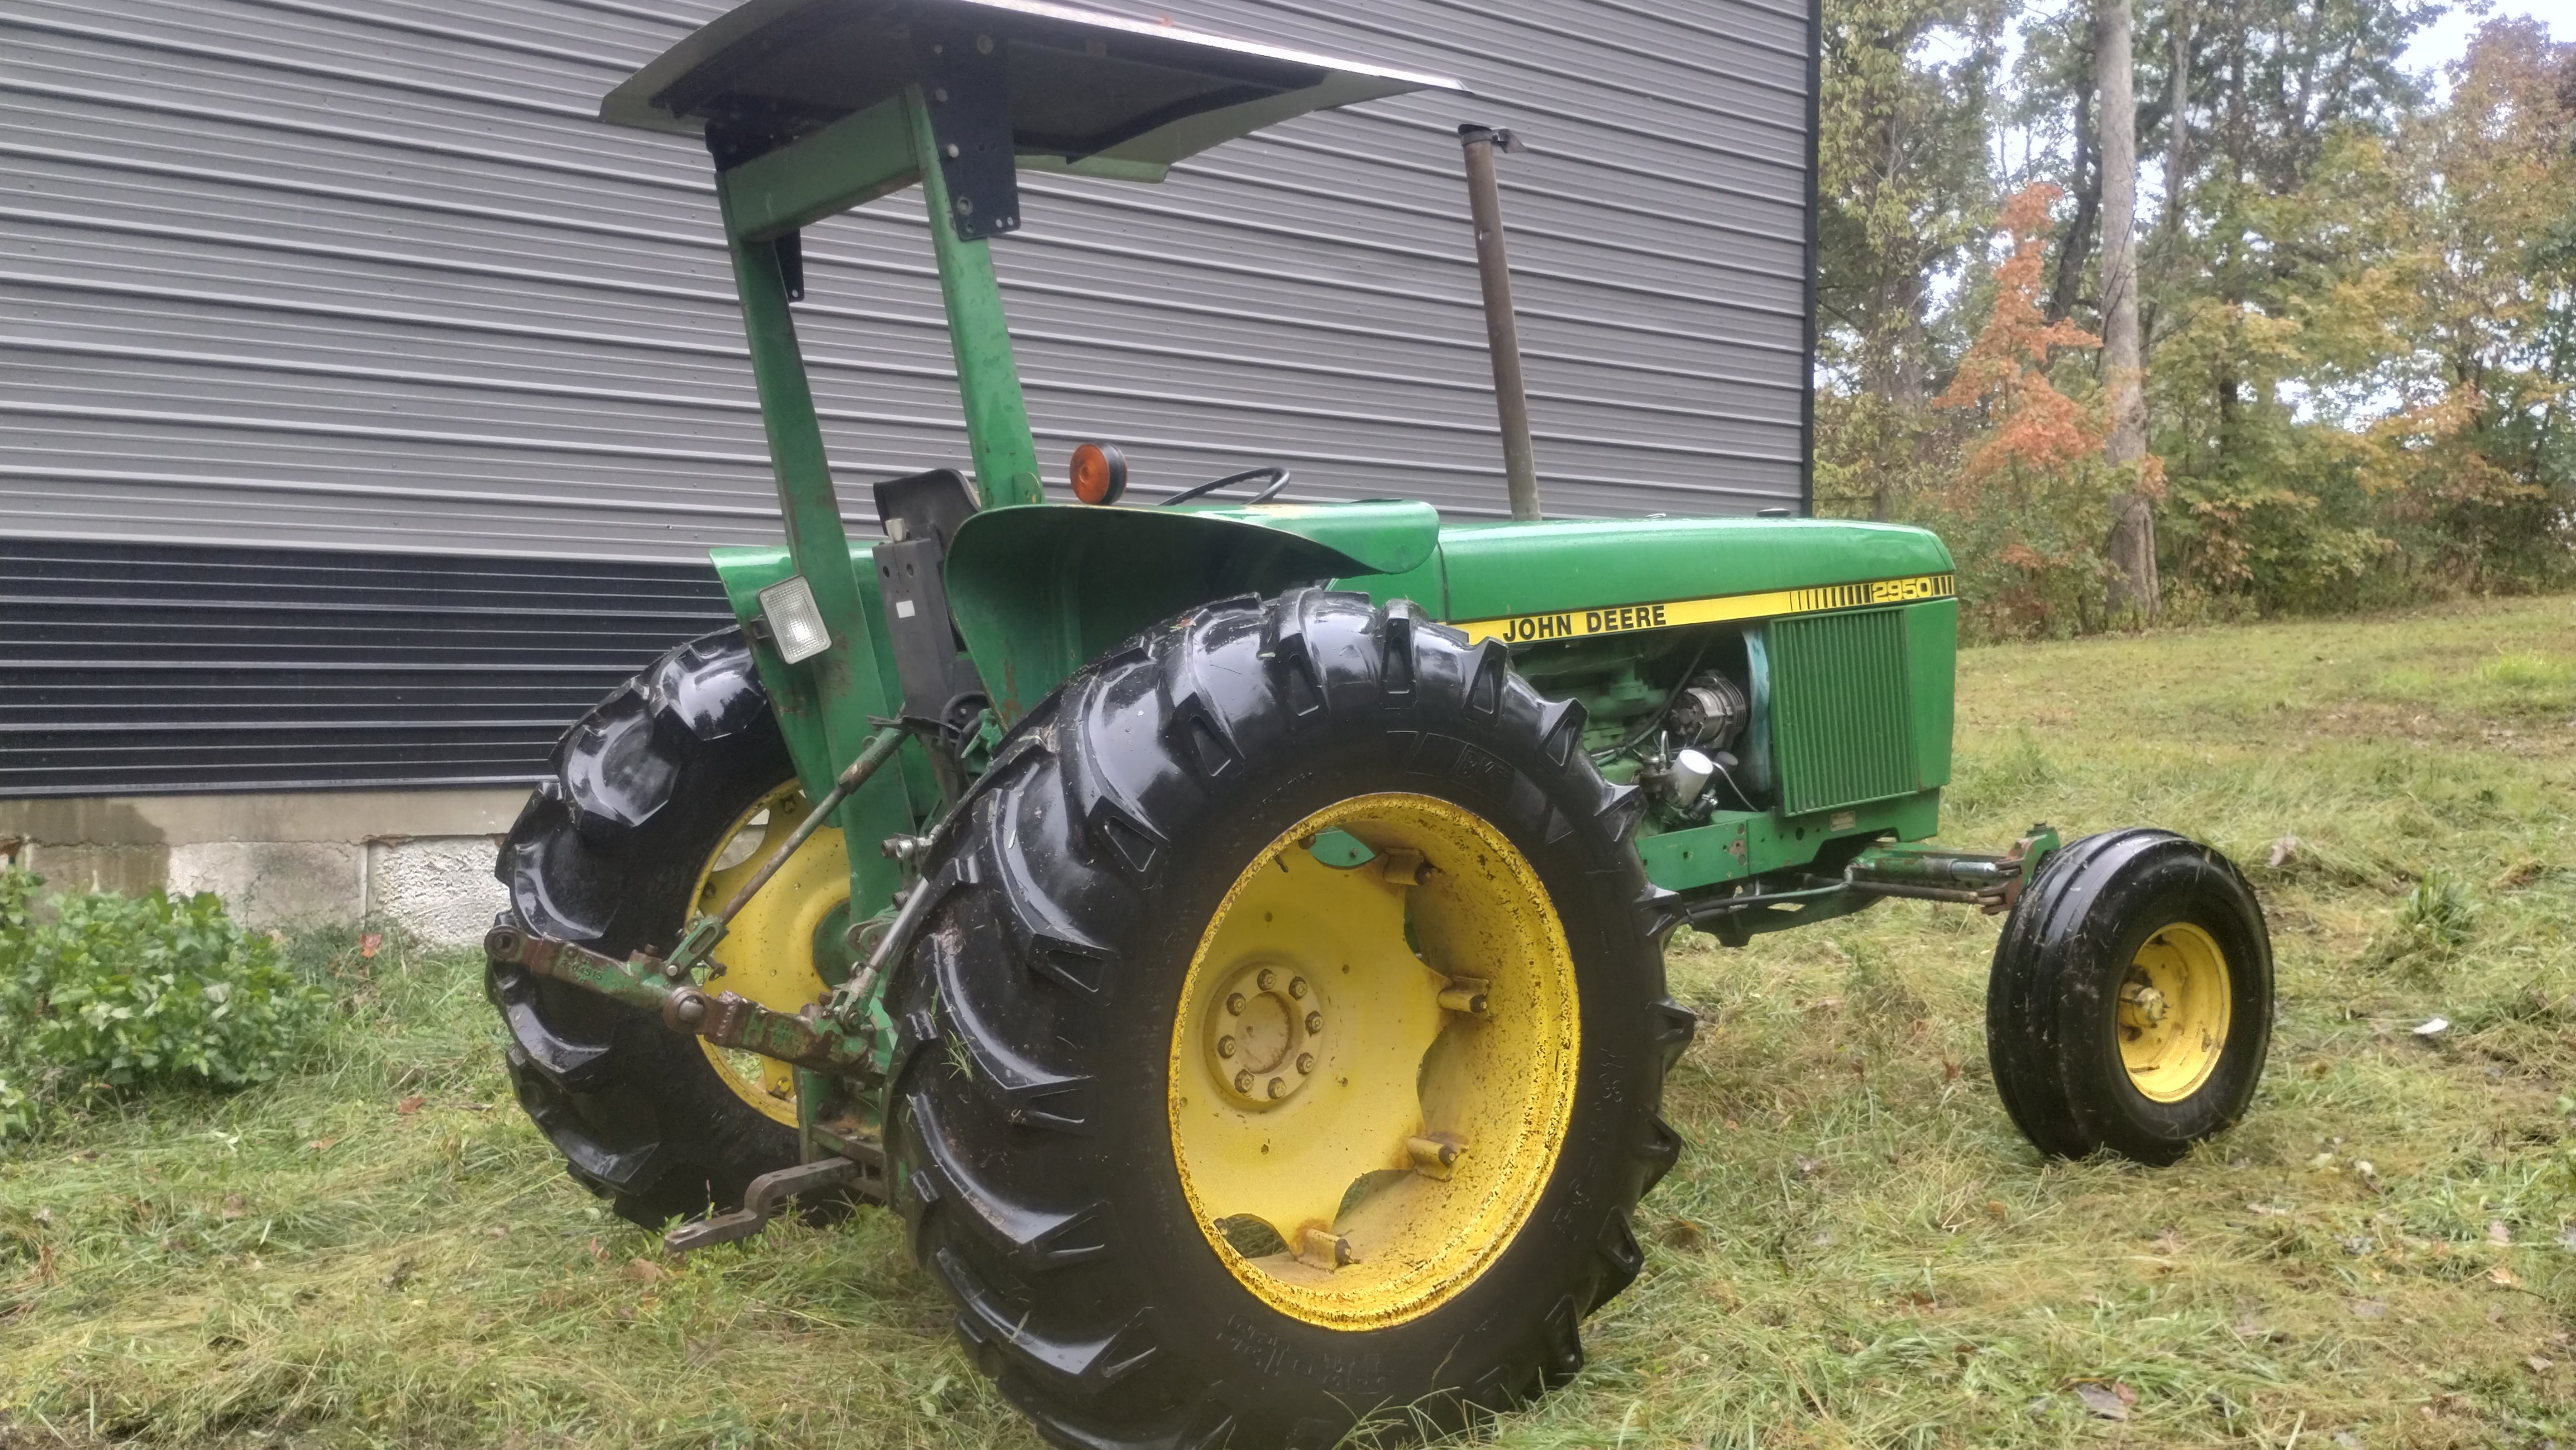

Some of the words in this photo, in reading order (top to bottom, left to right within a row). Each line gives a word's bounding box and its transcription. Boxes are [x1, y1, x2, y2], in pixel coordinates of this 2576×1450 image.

[1872, 577, 1932, 603] 2950
[1503, 614, 1572, 642] JOHN
[1586, 605, 1666, 633] DEERE
